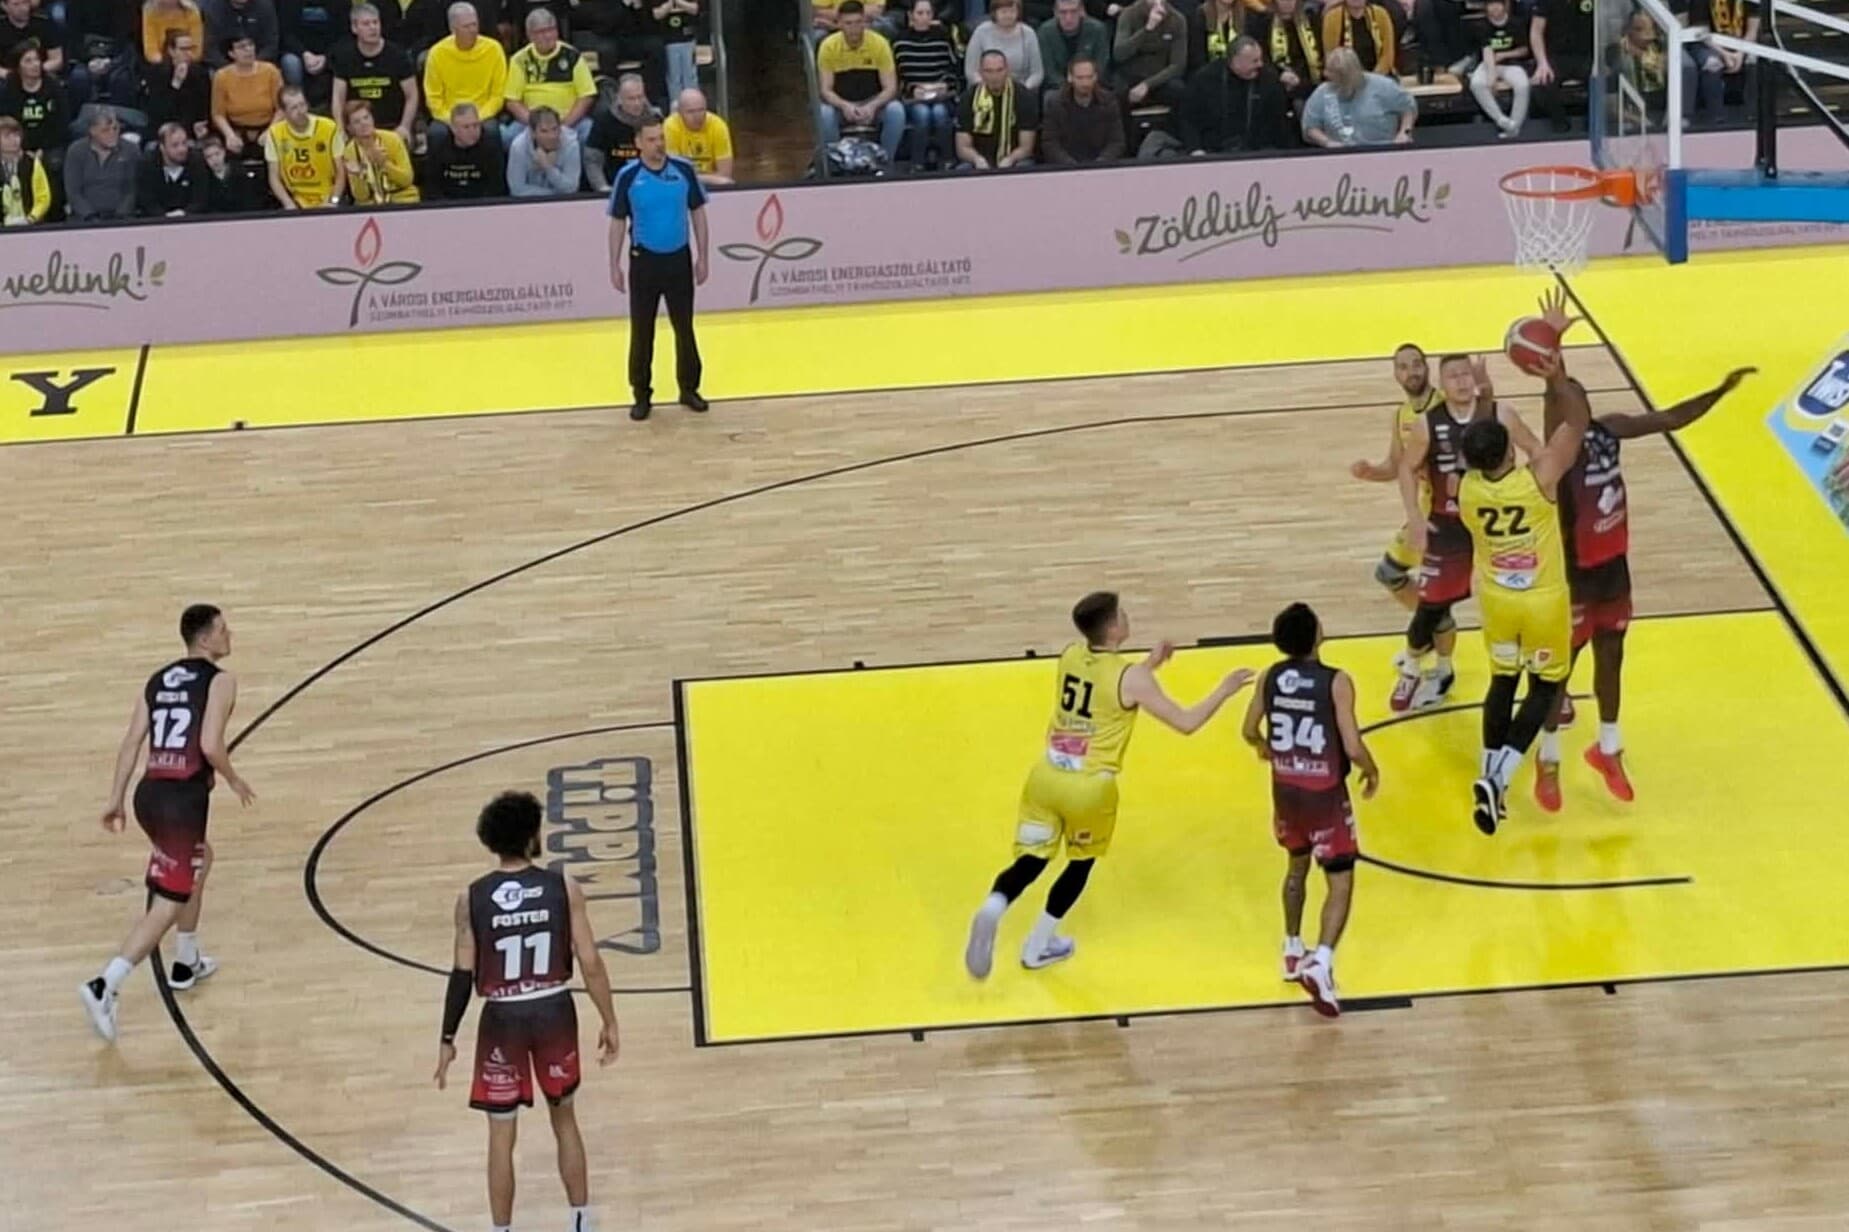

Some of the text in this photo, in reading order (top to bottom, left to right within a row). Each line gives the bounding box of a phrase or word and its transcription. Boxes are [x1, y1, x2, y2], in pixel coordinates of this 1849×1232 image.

[294, 148, 310, 162] 15
[1135, 169, 1431, 255] Zöldülj velünk!
[3, 246, 148, 301] velünk!
[769, 257, 972, 284] A VÁROSI ENERGIASZOLGÁLTATÓ
[369, 282, 573, 309] A VÁROSI ENERGIASZOLGÁLTATÓ
[10, 367, 117, 417] Y
[1477, 505, 1531, 537] 22
[1061, 672, 1093, 719] 51
[151, 708, 191, 748] 12
[1270, 712, 1326, 754] 34
[491, 909, 550, 930] FOSTER
[494, 931, 551, 980] 11
